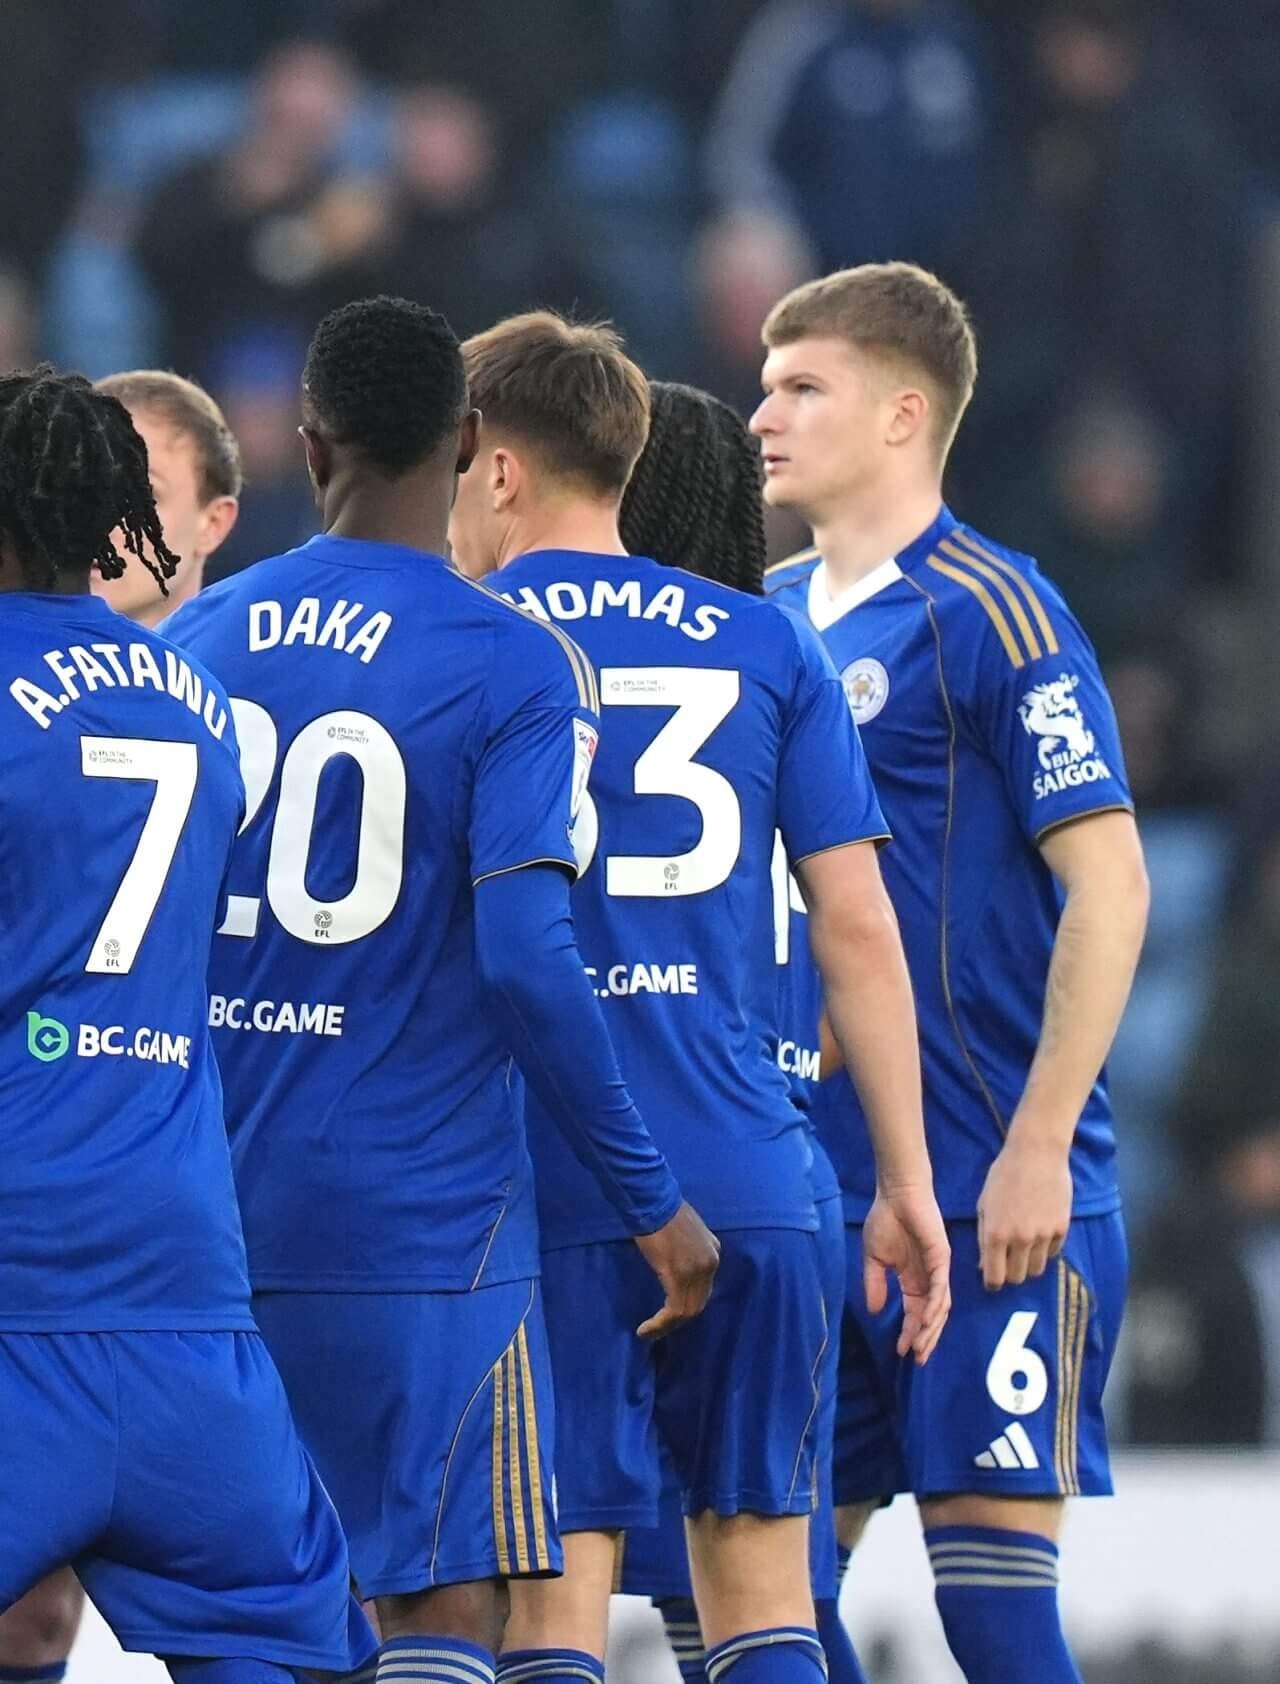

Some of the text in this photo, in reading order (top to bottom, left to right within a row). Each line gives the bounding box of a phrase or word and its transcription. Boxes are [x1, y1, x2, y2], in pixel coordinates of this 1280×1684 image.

[249, 597, 392, 664] DAKA
[9, 643, 227, 741] A.FATAWU
[575, 667, 740, 896] 3
[1033, 758, 1111, 800] SAIGON
[1051, 751, 1081, 769] BIA
[80, 735, 197, 973] 7
[314, 929, 330, 938] EFL
[106, 958, 120, 967] EFL
[208, 995, 345, 1036] BC.GAME
[77, 1024, 191, 1069] BC.GAME
[986, 1310, 1048, 1416] 6
